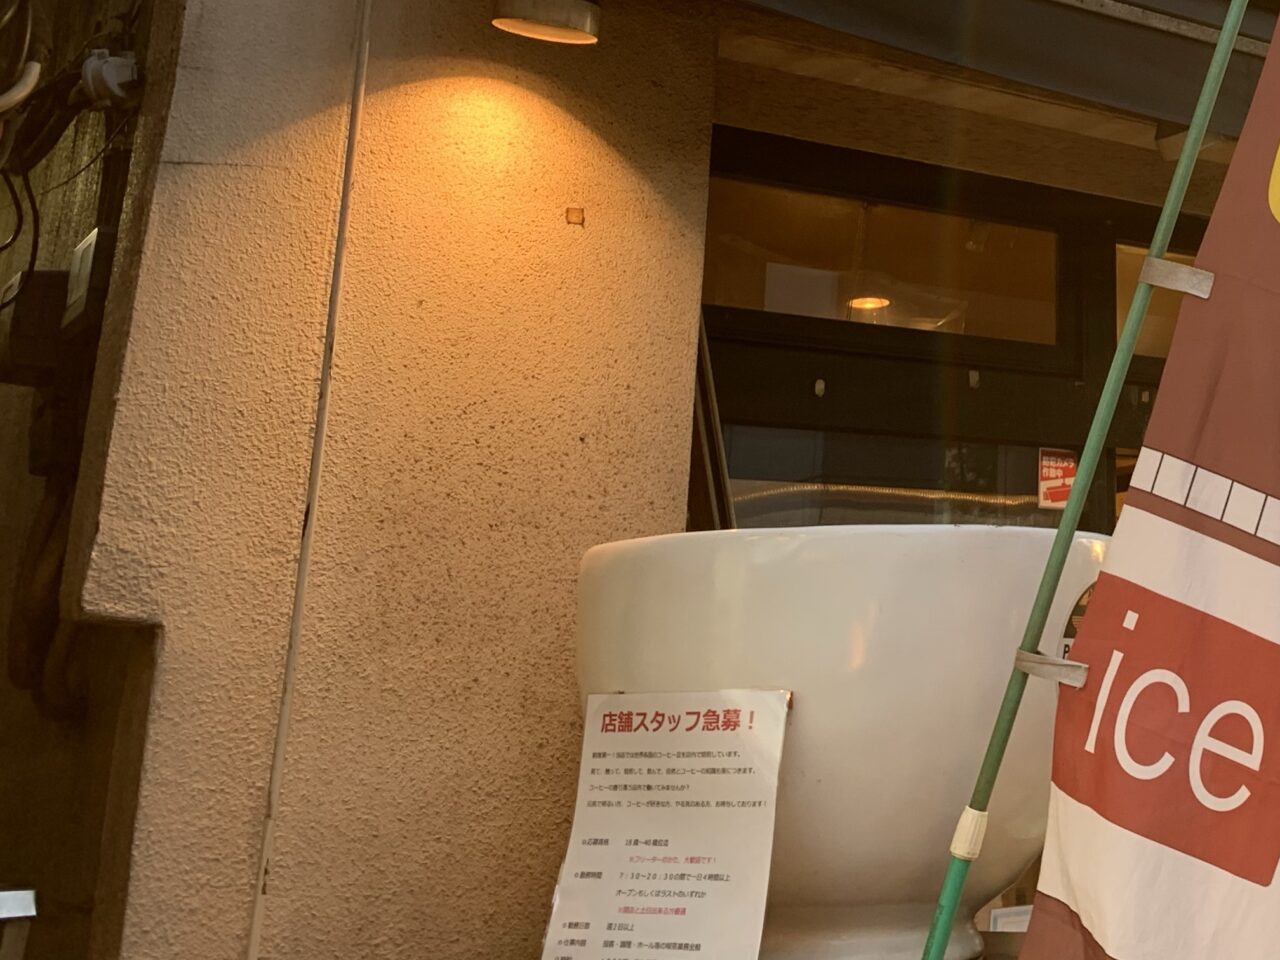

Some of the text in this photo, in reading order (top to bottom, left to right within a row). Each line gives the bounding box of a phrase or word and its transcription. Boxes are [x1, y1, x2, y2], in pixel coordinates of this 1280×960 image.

[600, 708, 755, 733] 店舗スタッフ急募！
[1084, 610, 1265, 812] ice
